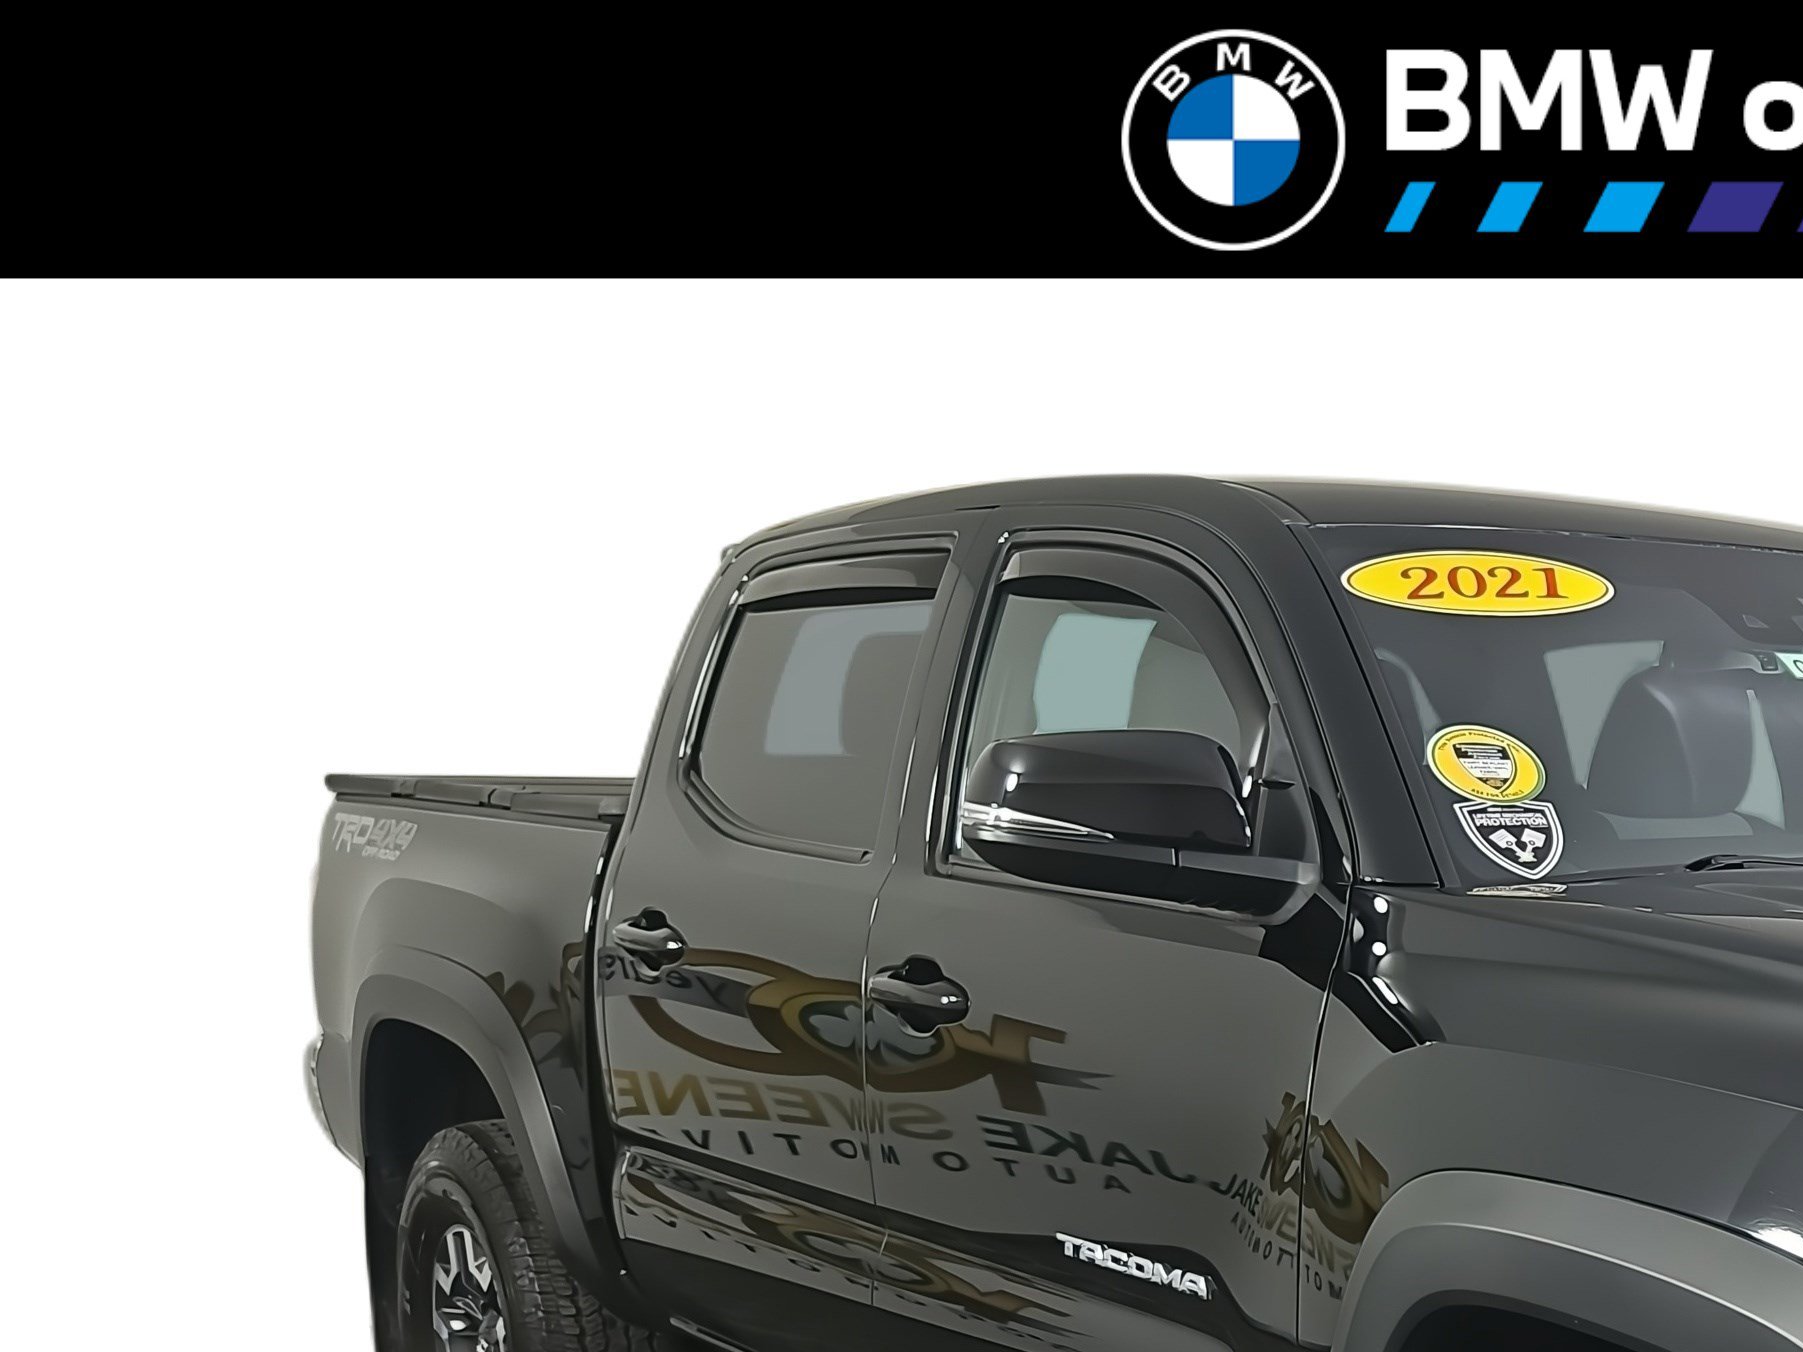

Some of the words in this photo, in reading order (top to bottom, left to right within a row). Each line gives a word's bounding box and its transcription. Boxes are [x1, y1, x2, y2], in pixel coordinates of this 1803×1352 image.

[1400, 565, 1569, 600] 2021
[331, 812, 375, 853] TRD
[1475, 816, 1548, 828] PROTECTION
[1055, 1231, 1208, 1301] TACOMA
